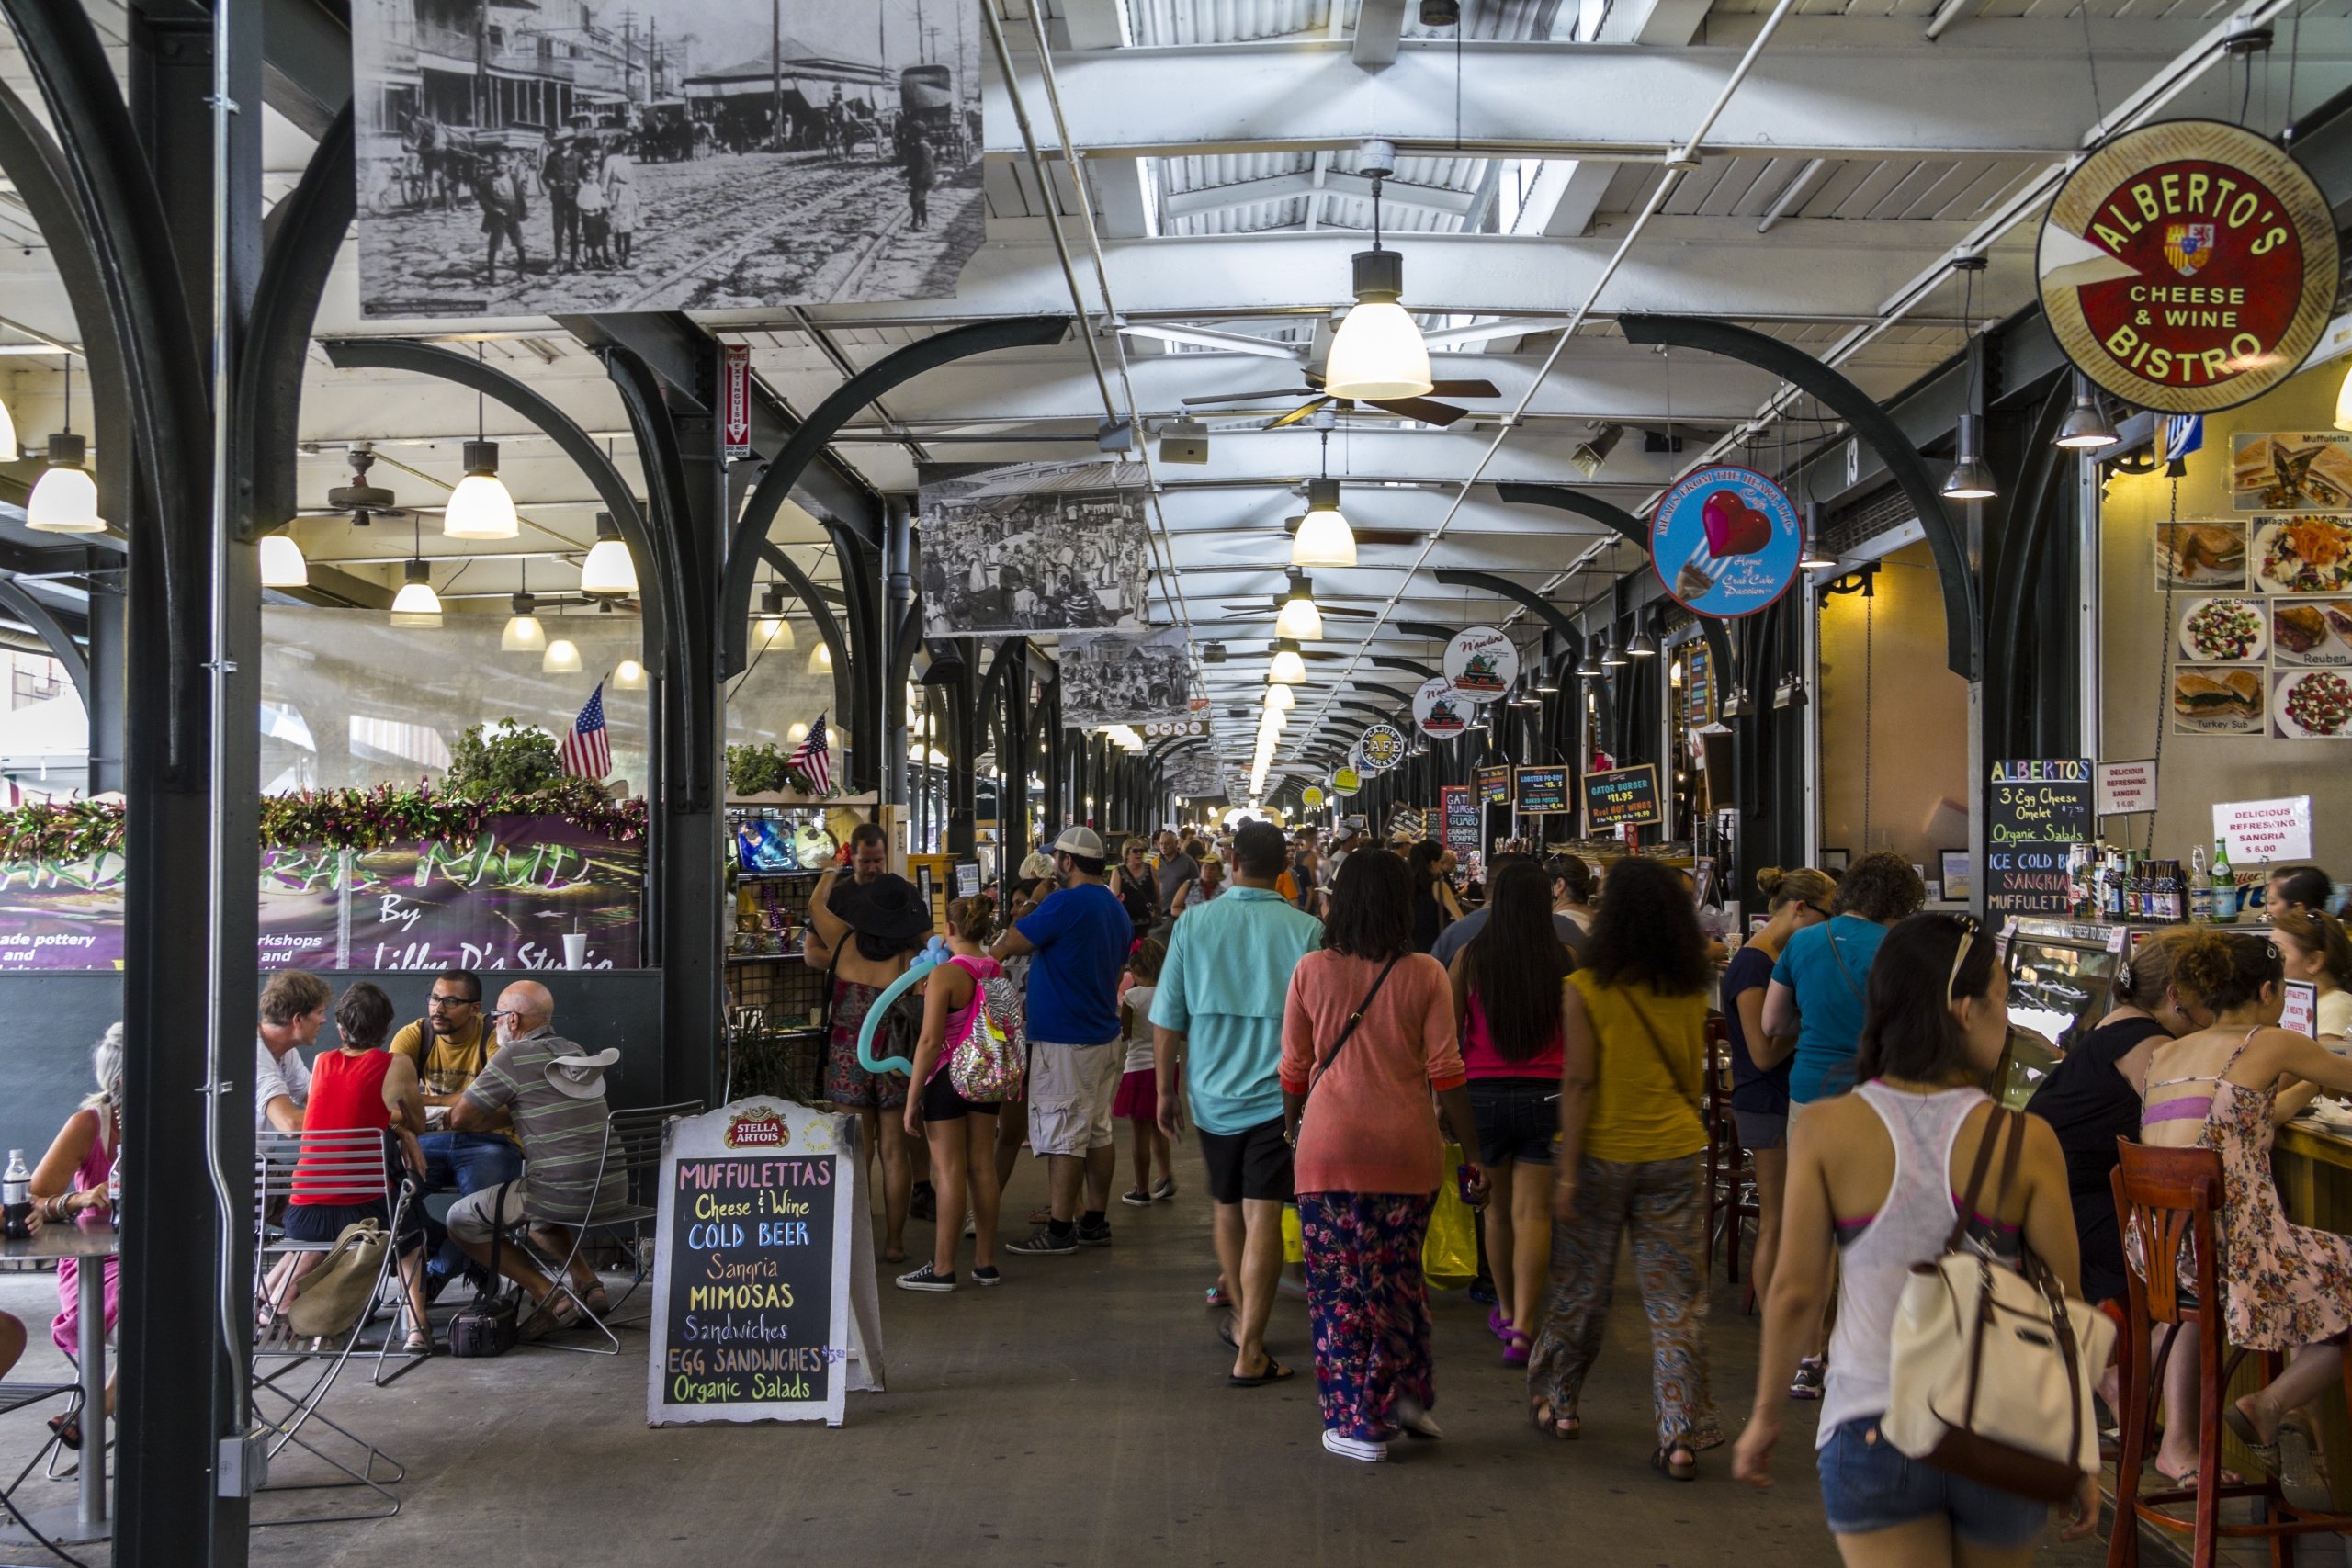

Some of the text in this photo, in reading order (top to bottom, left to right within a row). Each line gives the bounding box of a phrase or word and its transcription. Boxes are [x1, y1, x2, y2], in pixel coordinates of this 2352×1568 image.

[2093, 174, 2287, 254] ALBERTO'S
[2131, 286, 2245, 304] CHEESE
[2135, 310, 2237, 328] & WINE
[2106, 324, 2261, 381] BISTRO
[2302, 434, 2349, 443] Muffuletta
[1679, 473, 1713, 498] FROM
[1715, 470, 1741, 481] THE
[1734, 557, 1763, 567] Home
[1743, 566, 1754, 576] of
[1722, 574, 1775, 586] Crab Cake
[2303, 653, 2346, 664] Reuben
[2198, 719, 2248, 731] Turkey Sub
[1367, 727, 1396, 738] CAJUN
[1365, 753, 1397, 766] MARKET
[1991, 761, 2090, 780] ALBERTOS
[2110, 768, 2144, 776] DELICIOUS
[1591, 780, 1647, 795] GATOR BURGER
[2107, 778, 2147, 787] REFRESHING
[1447, 795, 1467, 804] GAT
[1608, 791, 1633, 802] $11.95
[1999, 787, 2077, 807] 3 Egg Cheese
[1447, 805, 1480, 814] BURGER
[1611, 805, 1625, 814] HOT
[1627, 800, 1652, 811] WINGS
[2016, 807, 2052, 821] Omelet
[2235, 808, 2290, 818] DELICIOUS
[1449, 817, 1478, 826] GUMBO
[2230, 819, 2296, 830] REFRESHING
[1993, 824, 2084, 848] Organic Salads
[2239, 832, 2286, 841] SANGRIA
[1989, 853, 2012, 869] ICE
[2018, 853, 2052, 869] COLD
[2003, 873, 2069, 891] SANGRIA
[2235, 872, 2263, 886] iller
[1988, 894, 2068, 910] MUFFULETT
[380, 894, 421, 931] By
[0, 934, 96, 948] ade pottery
[258, 933, 322, 949] rkshops
[2097, 927, 2112, 941] ORDE
[3, 950, 34, 961] and
[261, 950, 292, 962] and
[517, 942, 614, 970] Stuio
[737, 1123, 778, 1133] STELLA
[736, 1133, 779, 1142] ARTOIS
[680, 1161, 831, 1190] MUFFULETTAS
[695, 1194, 751, 1223] Cheese
[770, 1190, 809, 1218] Wine
[689, 1221, 809, 1249] COLD BEER
[707, 1253, 777, 1286] Sangria
[691, 1283, 794, 1311] MIMOSAS
[684, 1312, 787, 1344] Sandwiches
[668, 1348, 705, 1376] EGG
[714, 1347, 821, 1373] SANDWICHES
[674, 1372, 810, 1403] Organic Salads
